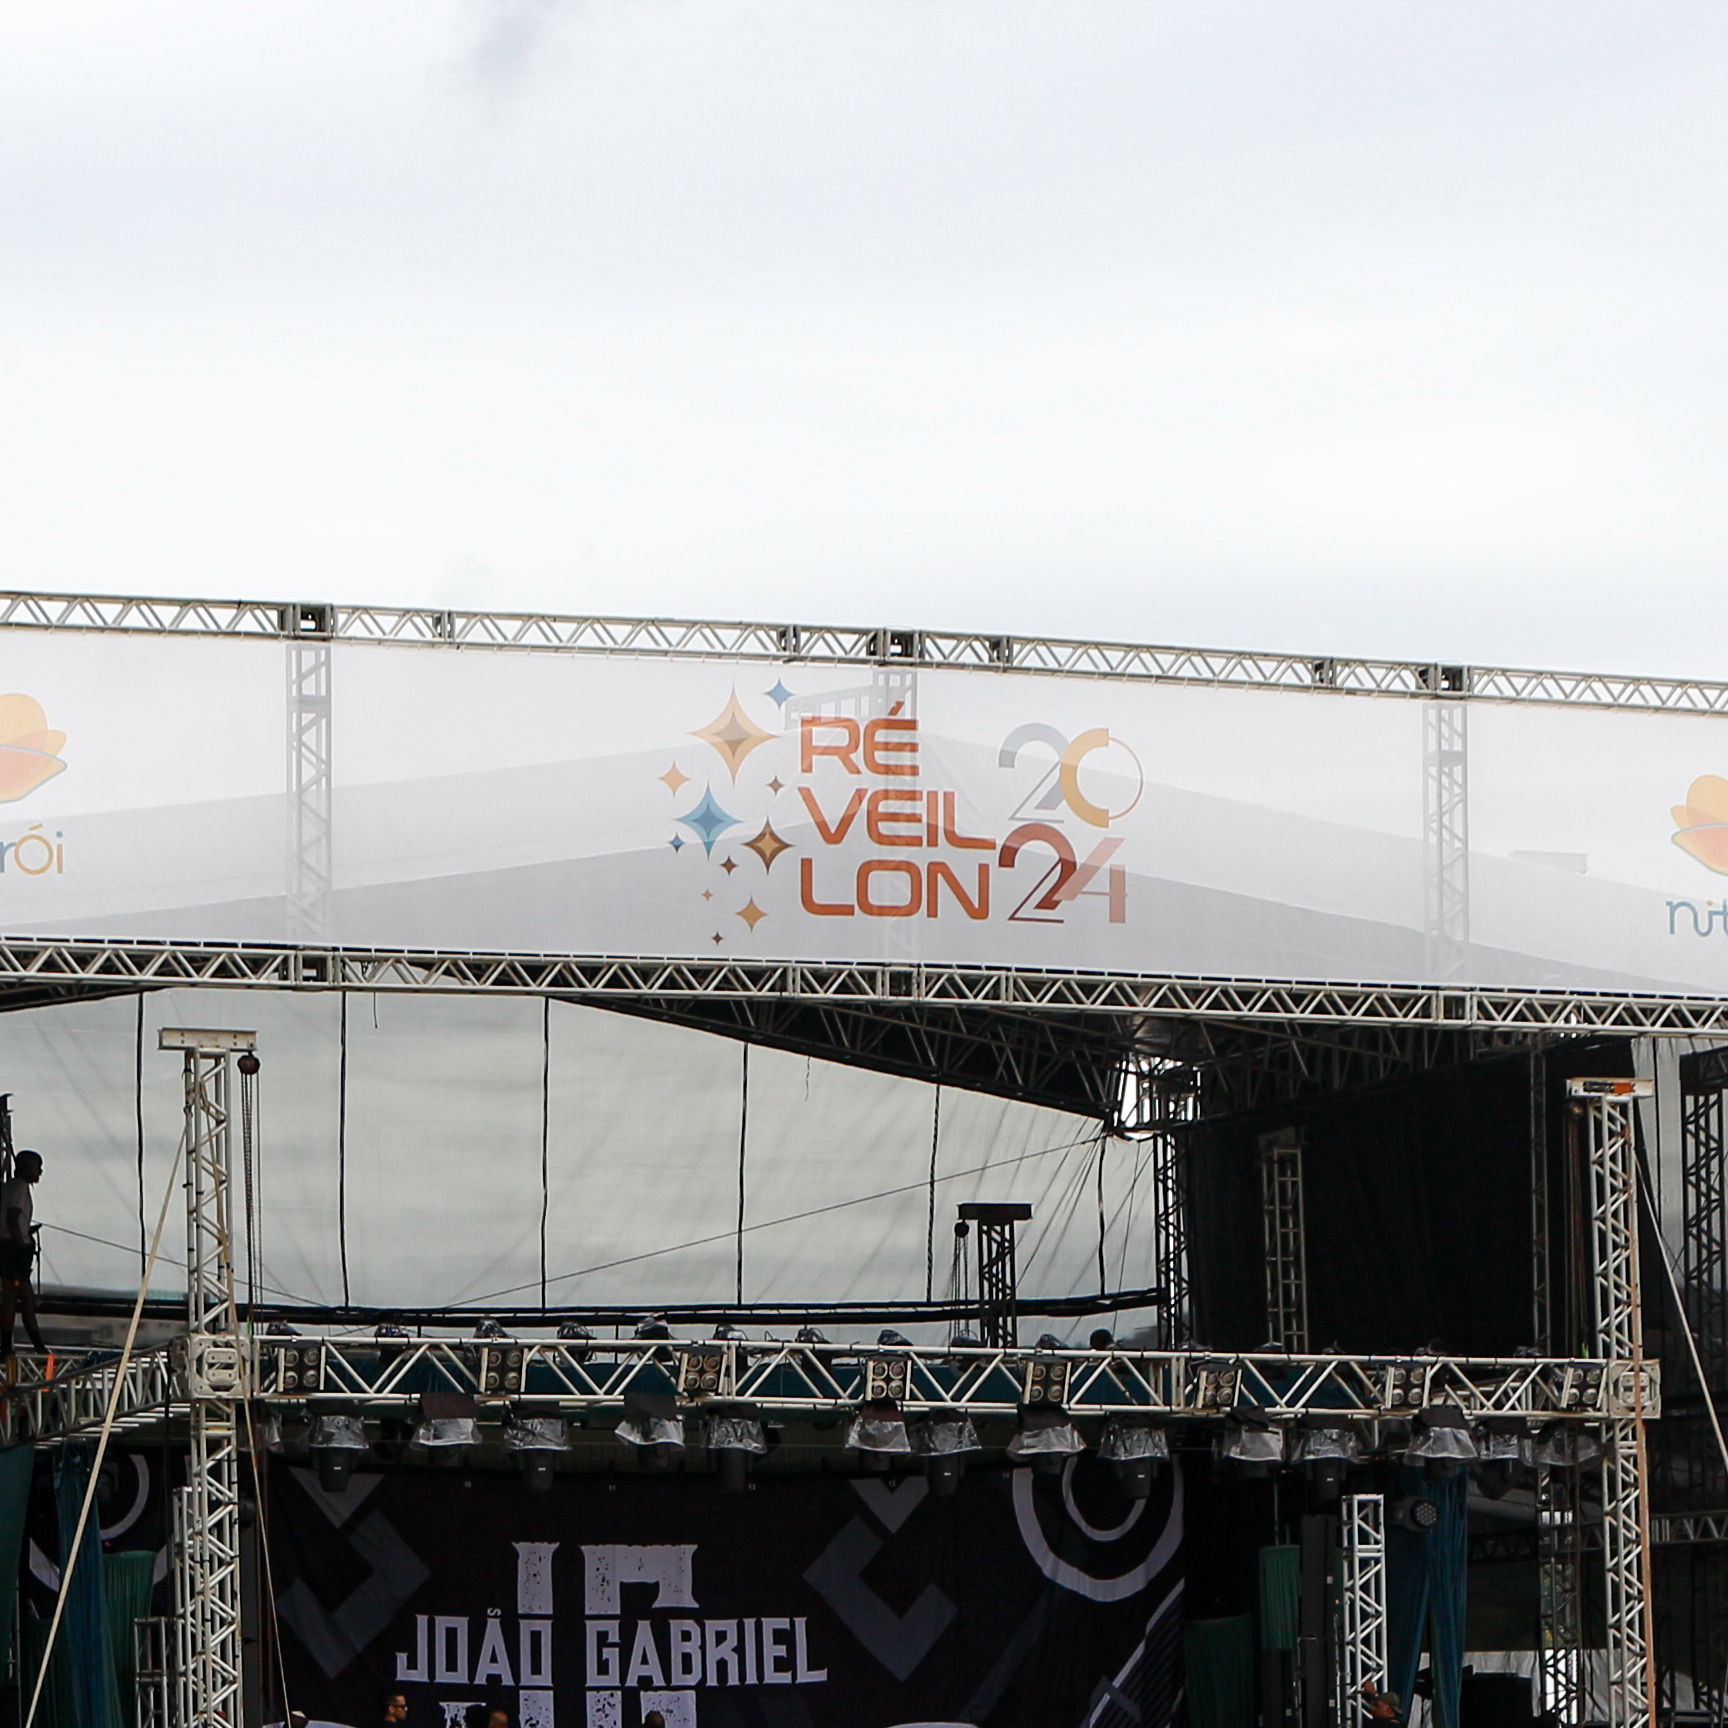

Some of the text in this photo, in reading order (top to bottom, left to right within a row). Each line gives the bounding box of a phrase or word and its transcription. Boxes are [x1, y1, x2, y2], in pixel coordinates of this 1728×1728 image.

[800, 701, 919, 775] RÉ
[798, 787, 996, 850] VEIL
[800, 857, 989, 920] LON
[396, 1607, 829, 1686] JOÃO GABRIEL
